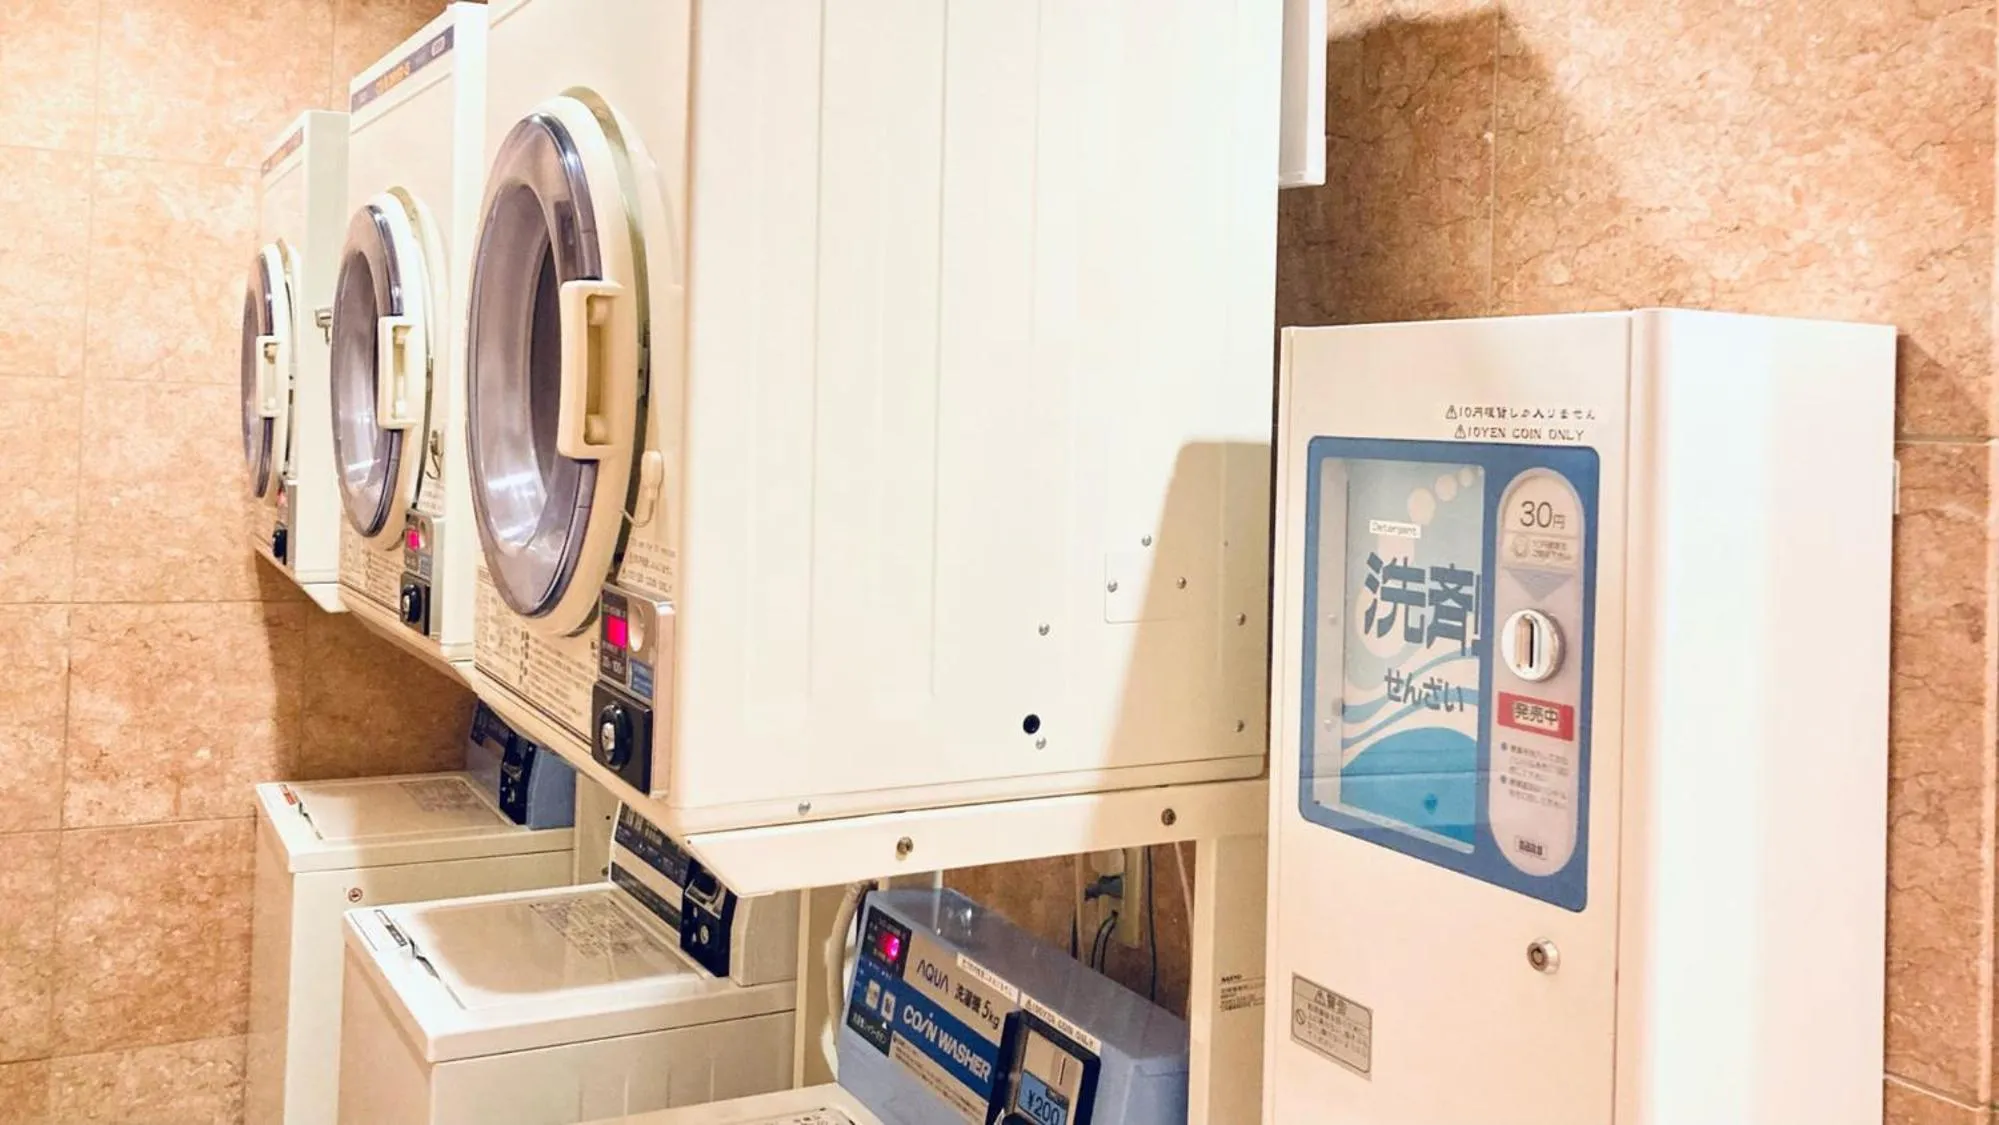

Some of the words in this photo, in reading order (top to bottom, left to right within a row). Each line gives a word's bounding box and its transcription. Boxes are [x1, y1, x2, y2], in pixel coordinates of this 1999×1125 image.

[1512, 427, 1541, 439] COIN
[1548, 428, 1584, 441] ONLY
[1371, 521, 1417, 537] Detergent
[1520, 500, 1566, 529] 30円
[1364, 552, 1480, 657] 洗剤
[1384, 667, 1464, 713] せんざい
[1513, 701, 1559, 726] 発売中
[916, 959, 949, 993] AQUA
[938, 1029, 992, 1083] WASHER
[1027, 1088, 1061, 1125] ¥200
